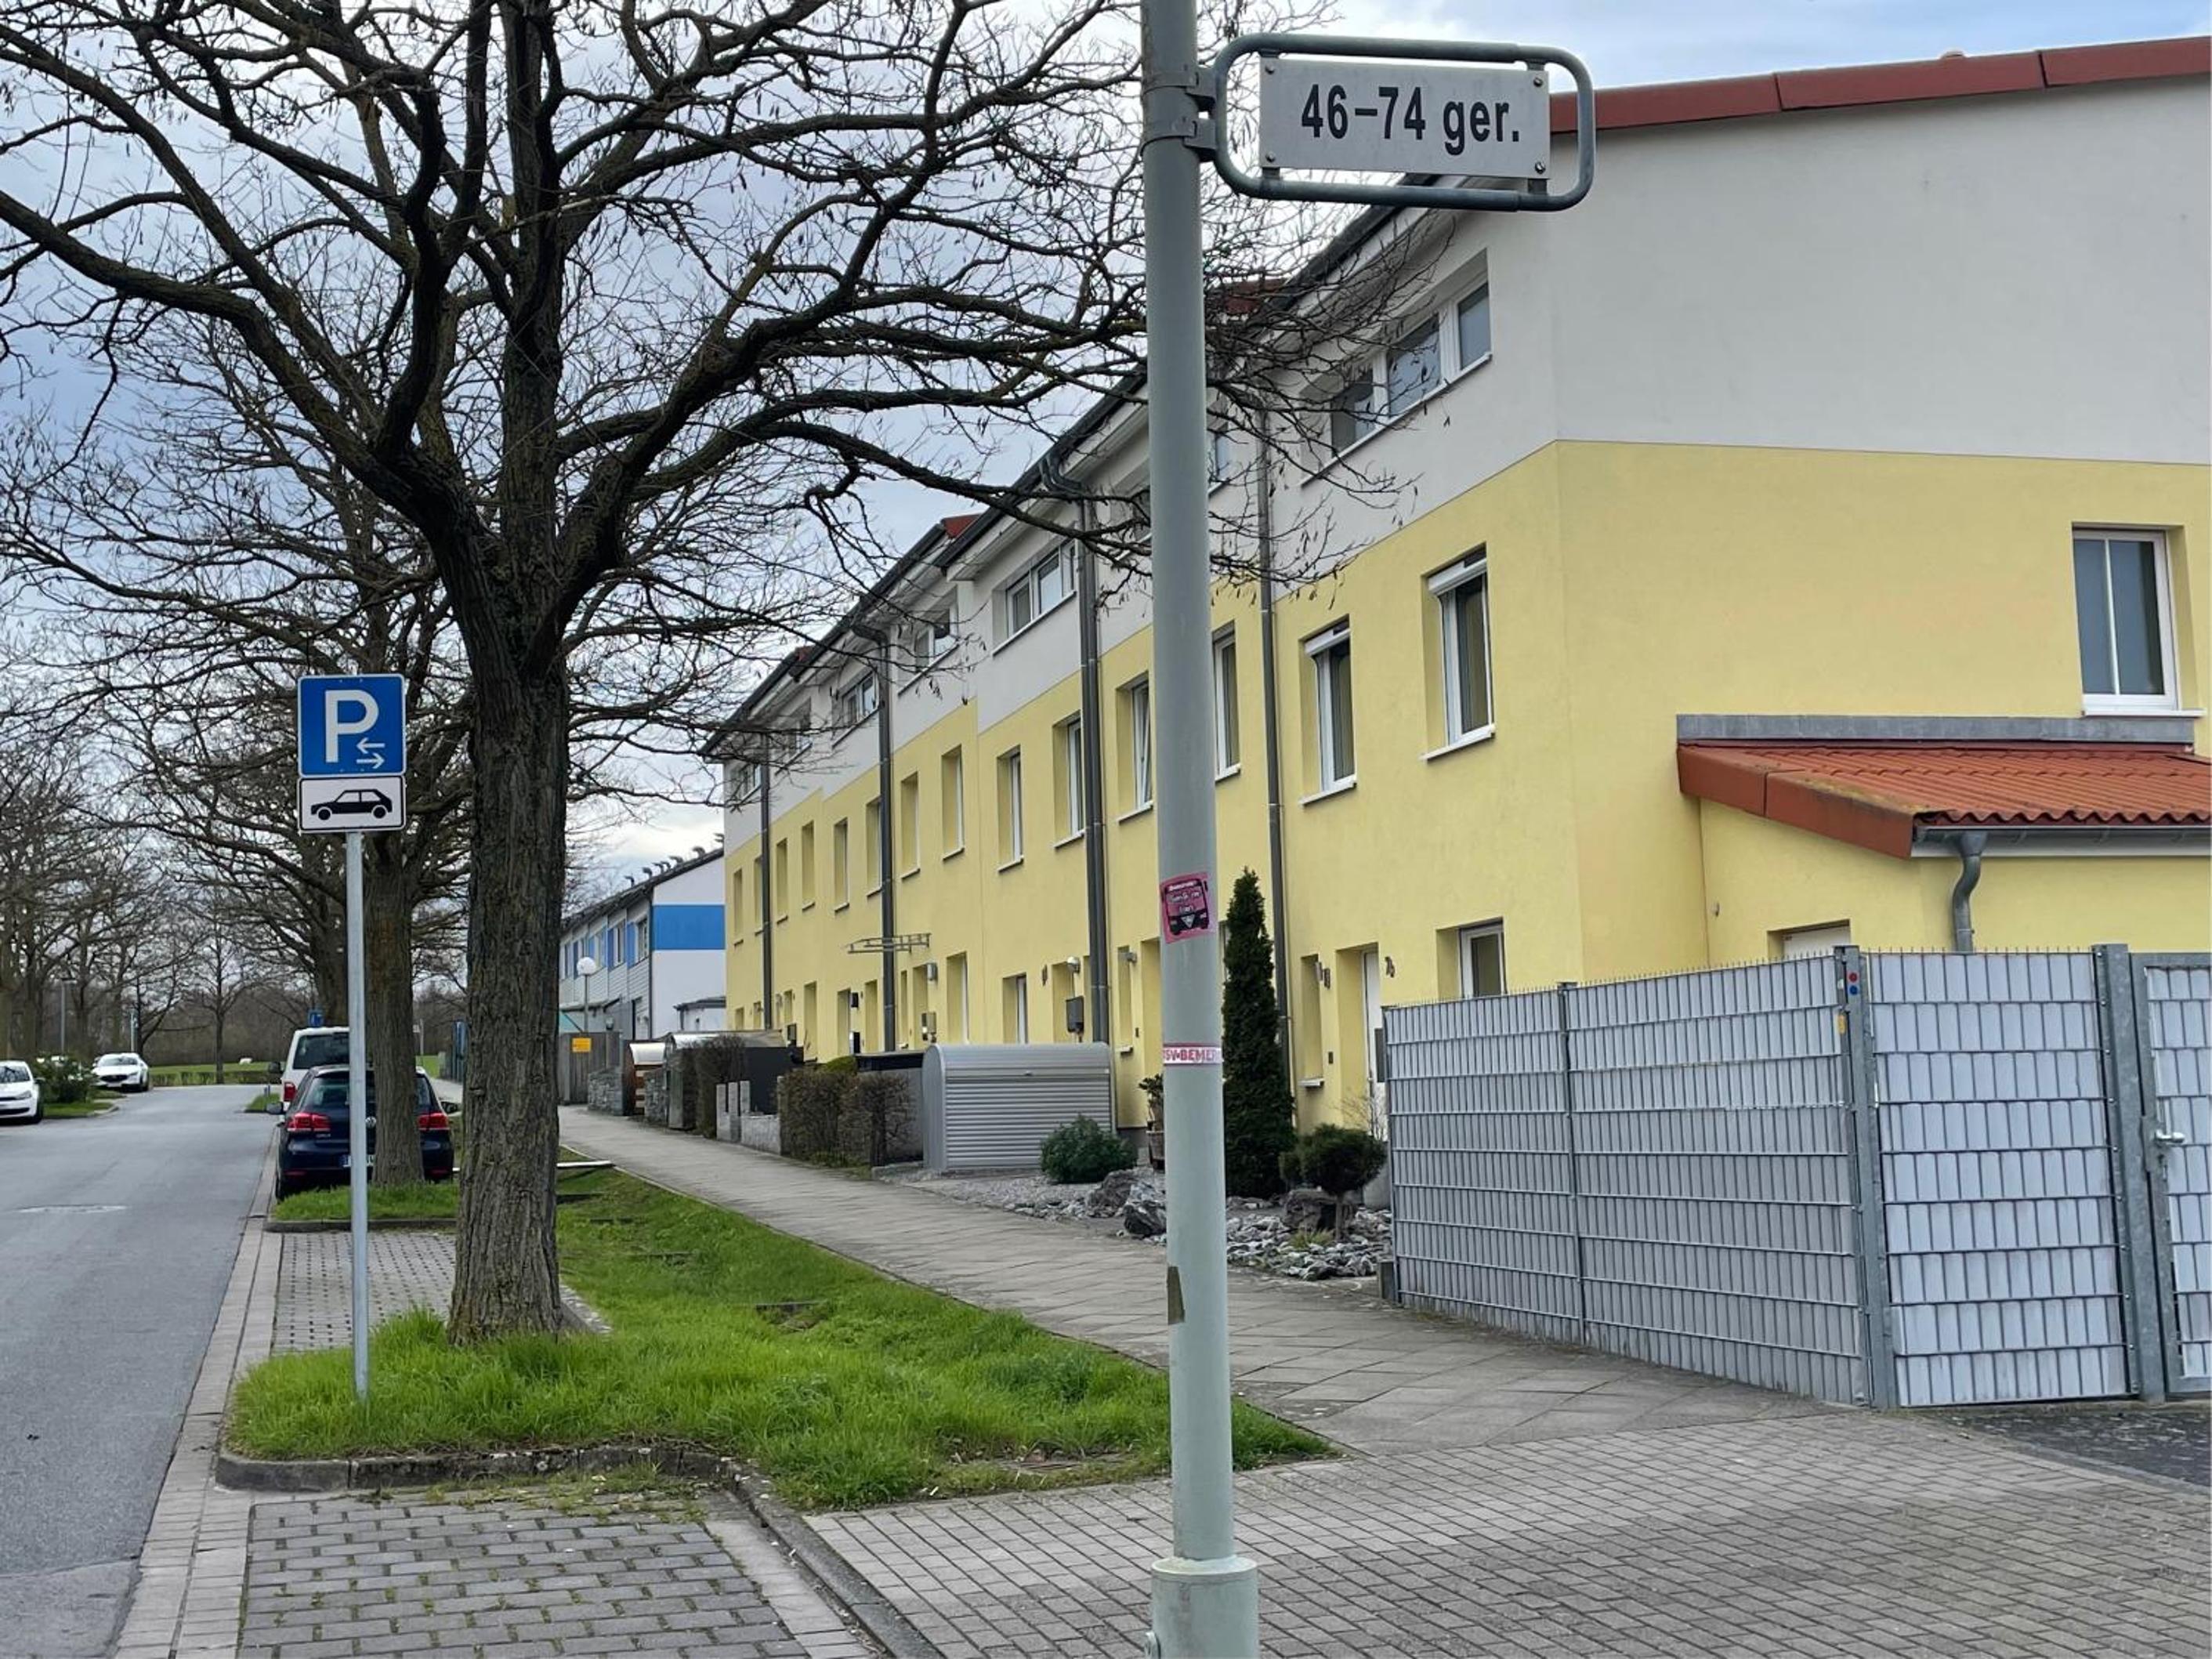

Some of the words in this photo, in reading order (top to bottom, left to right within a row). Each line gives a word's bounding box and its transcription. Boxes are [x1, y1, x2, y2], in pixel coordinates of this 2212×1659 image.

[1301, 84, 1426, 140] 46-74
[1443, 100, 1520, 156] ger.
[325, 689, 379, 763] P
